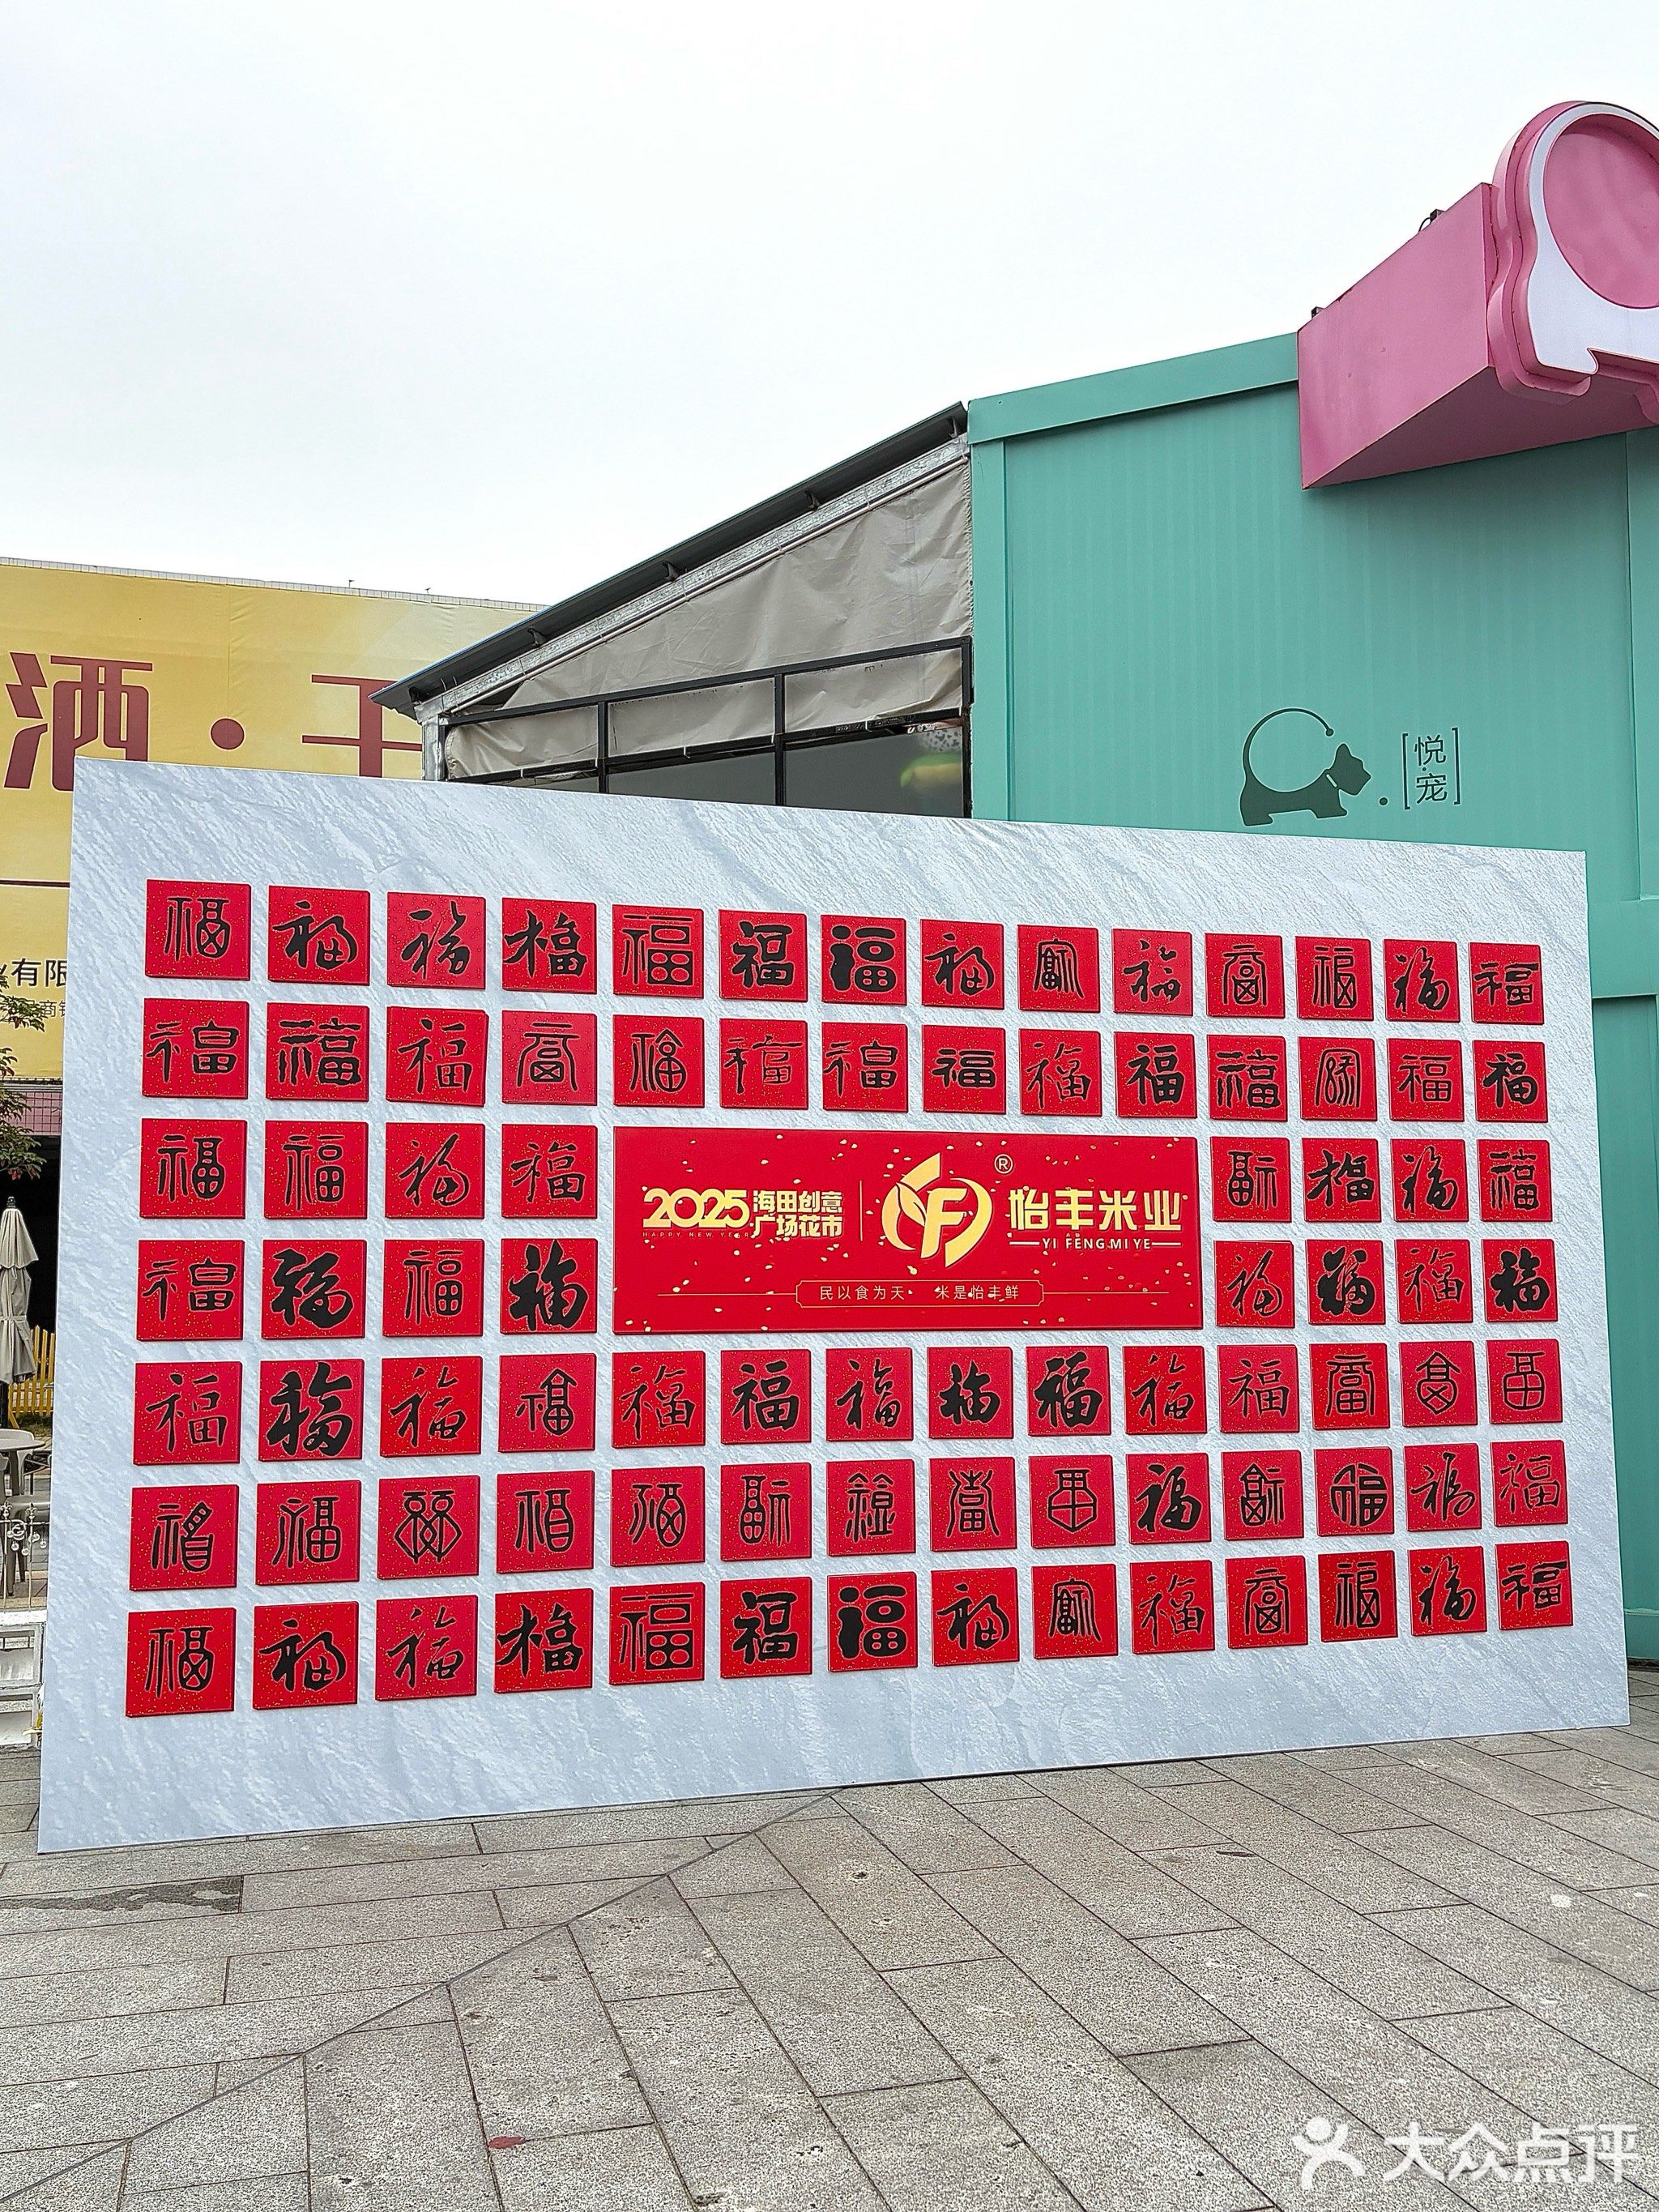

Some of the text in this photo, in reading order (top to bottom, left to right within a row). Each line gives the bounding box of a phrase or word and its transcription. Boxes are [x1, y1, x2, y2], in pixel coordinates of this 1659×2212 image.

[642, 1188, 751, 1229] 2025
[753, 1189, 842, 1214] 海田创意
[1009, 1188, 1182, 1231] 怡丰米业
[753, 1215, 843, 1238] 广场花市
[1042, 1237, 1150, 1250] YI FENG MI YE
[819, 1284, 1019, 1301] 民以食为天 米是怡丰鲜
